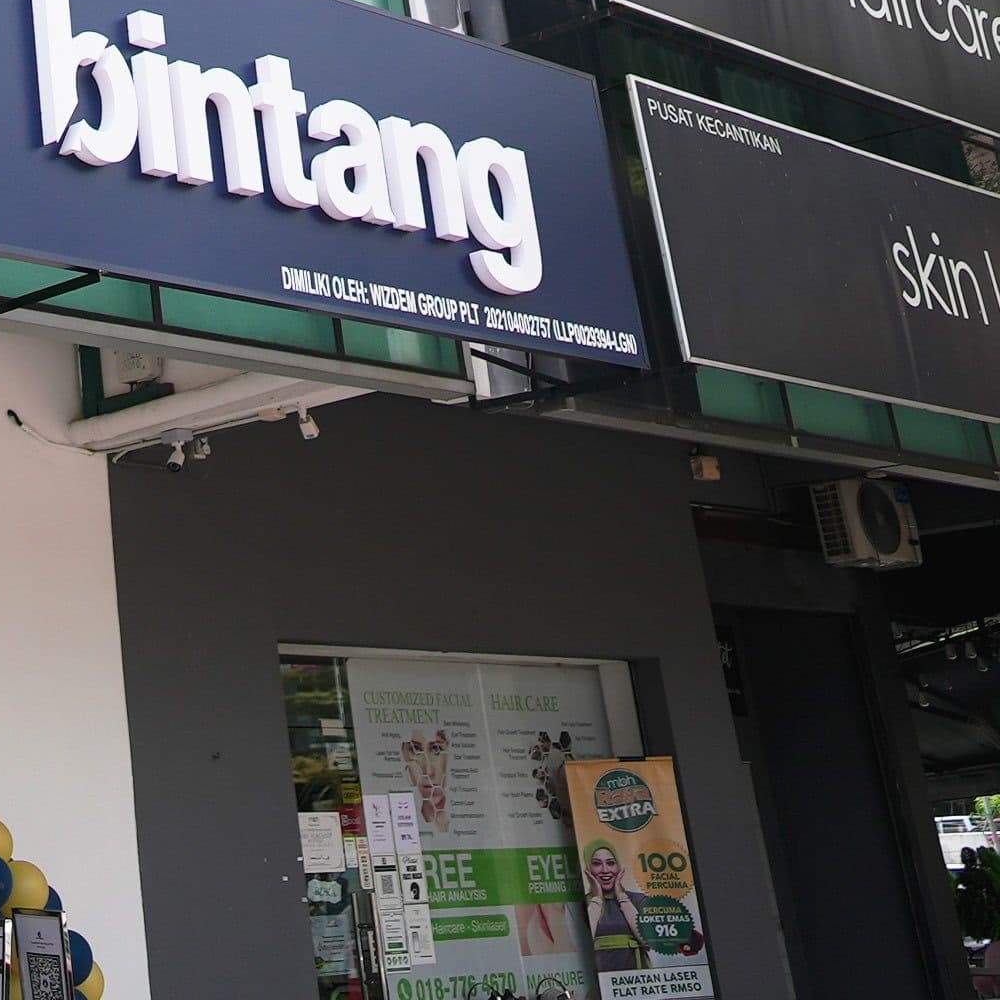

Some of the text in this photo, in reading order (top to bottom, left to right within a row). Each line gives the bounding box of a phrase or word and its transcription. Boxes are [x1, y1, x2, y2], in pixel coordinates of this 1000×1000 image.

[647, 97, 783, 156] PUSAT KECANTIKAN
[892, 225, 990, 326] skin
[281, 266, 332, 298] DIMILIKI
[332, 275, 370, 305] OLEH:
[369, 283, 417, 314] WIZDEM
[417, 292, 458, 322] GROUP
[459, 301, 480, 326] PLT
[483, 306, 552, 338] 202104002757
[363, 690, 473, 708] CUSTOMIZED FACIAL
[491, 693, 560, 713] HAIR CARE
[366, 707, 440, 724] TREATMENT
[597, 801, 657, 822] EXTRA
[422, 852, 477, 889] REE
[638, 852, 688, 873] 100
[647, 880, 689, 890] PERCUMA
[650, 872, 681, 881] FACIAL
[448, 888, 488, 903] ANALYSIS
[642, 906, 682, 914] PERCUMA
[639, 914, 691, 924] LOKET EMAS
[655, 924, 679, 937] 916
[611, 971, 699, 987] RAWATAN LASER
[613, 986, 637, 998] FLAT
[641, 984, 669, 996] RATE
